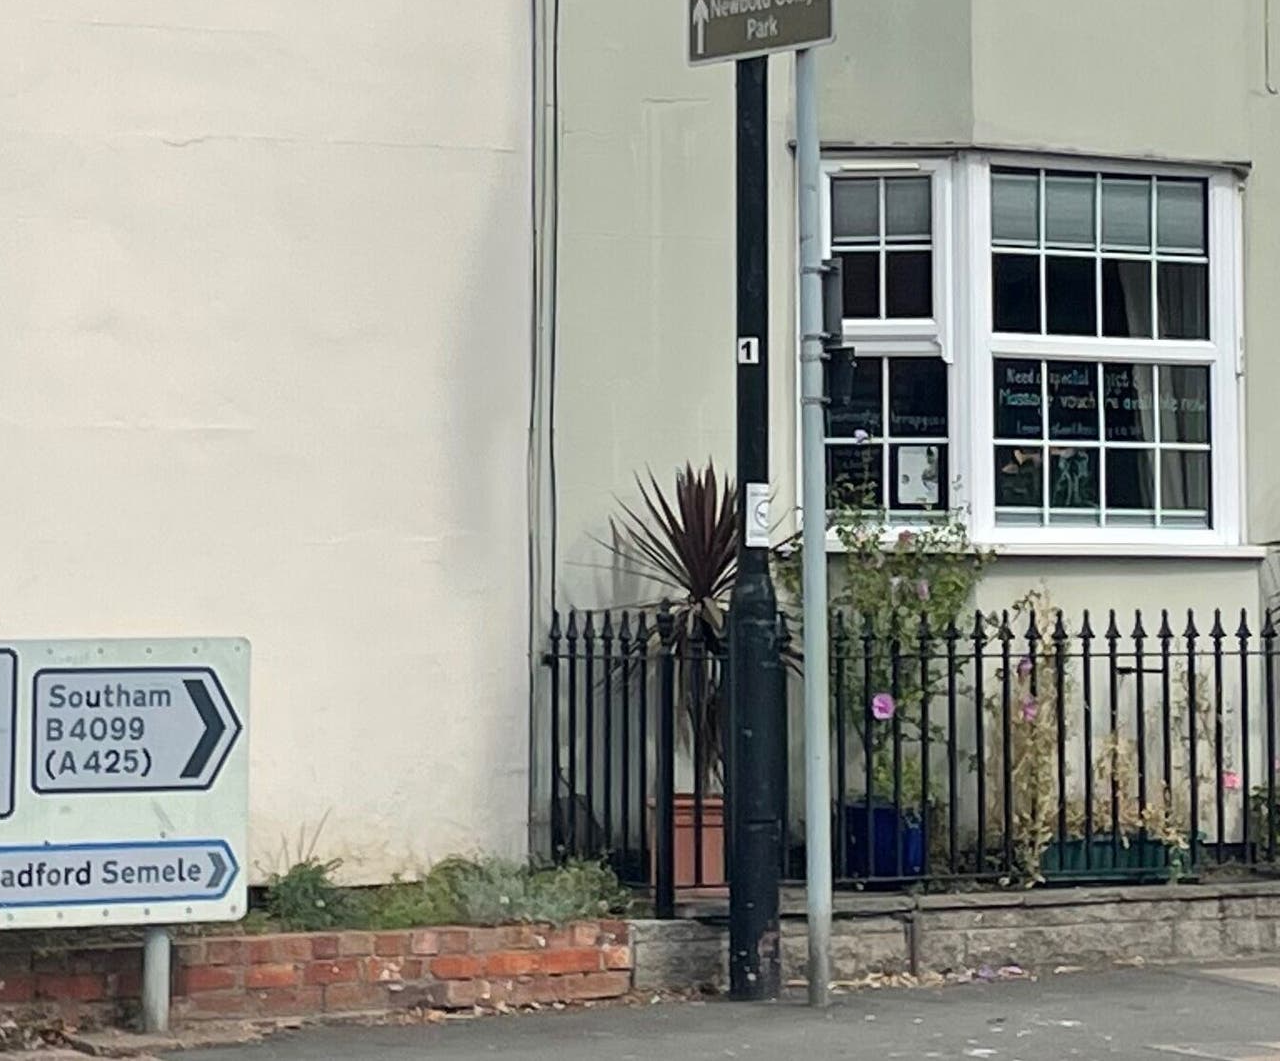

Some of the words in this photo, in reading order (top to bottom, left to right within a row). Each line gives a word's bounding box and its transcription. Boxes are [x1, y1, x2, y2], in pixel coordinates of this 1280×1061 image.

[746, 15, 778, 41] Park
[741, 340, 752, 360] 1
[48, 683, 171, 709] Southam
[102, 857, 202, 885] Semele
